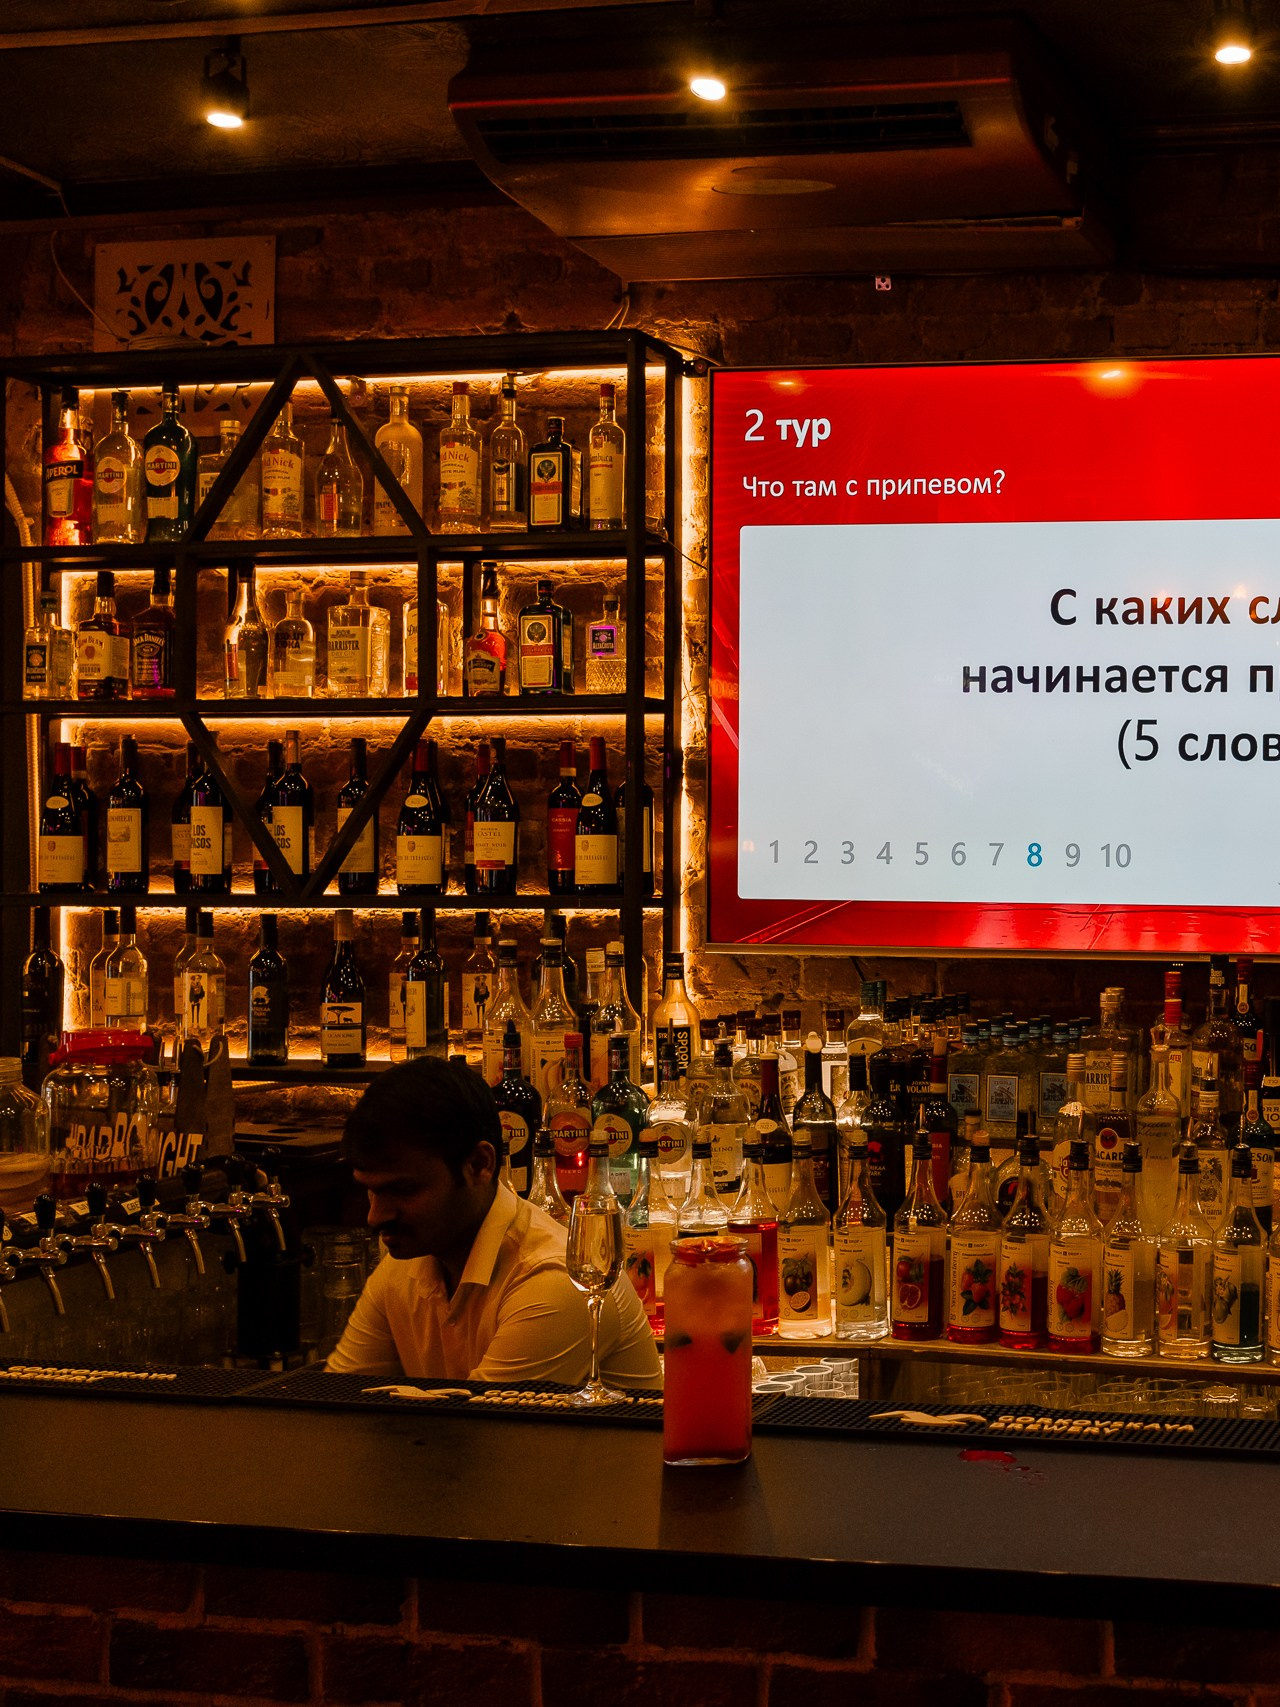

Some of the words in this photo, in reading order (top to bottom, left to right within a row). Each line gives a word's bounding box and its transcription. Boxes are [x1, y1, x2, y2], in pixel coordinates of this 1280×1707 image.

[744, 409, 765, 441] 2
[776, 417, 831, 448] тур
[272, 456, 295, 468] Nick
[448, 451, 470, 463] Nick
[742, 476, 785, 497] Что
[792, 479, 837, 497] там
[845, 479, 858, 496] с
[867, 470, 1006, 501] припевом?
[1050, 588, 1077, 626] С
[1095, 596, 1231, 626] каких
[962, 664, 1228, 694] начинается
[1117, 719, 1159, 770] (5
[193, 824, 206, 836] LOS
[274, 824, 286, 836] LOS
[769, 840, 780, 863] 1
[804, 841, 818, 864] 2
[840, 841, 855, 865] 3
[876, 841, 893, 865] 4
[915, 842, 929, 865] 5
[951, 842, 967, 866] 6
[988, 842, 1004, 866] 7
[1027, 843, 1042, 867] 8
[1065, 843, 1081, 867] 9
[1100, 844, 1132, 868] 10
[658, 1032, 676, 1040] SYRP
[677, 1031, 689, 1070] SPOOM
[1266, 1112, 1280, 1122] 10
[552, 1128, 589, 1138] MARTINI
[989, 1422, 1121, 1436] BREWERY
[998, 1415, 1195, 1433] GORKOVSKAYA
